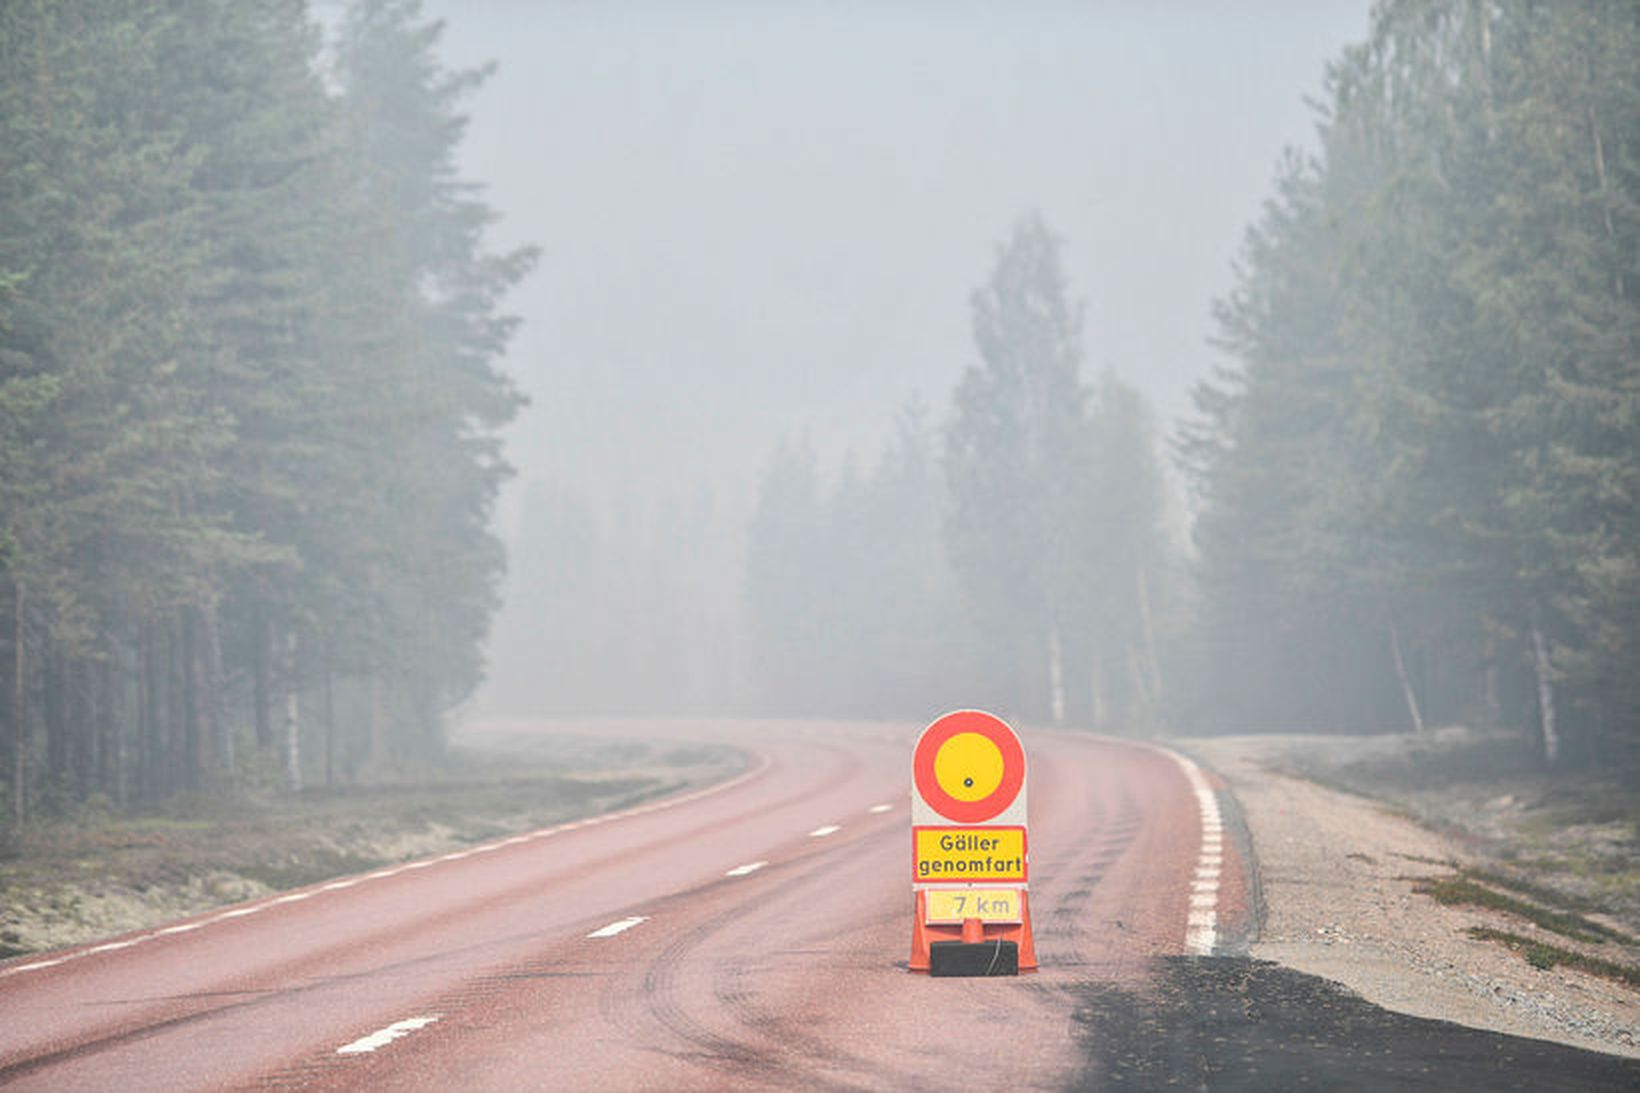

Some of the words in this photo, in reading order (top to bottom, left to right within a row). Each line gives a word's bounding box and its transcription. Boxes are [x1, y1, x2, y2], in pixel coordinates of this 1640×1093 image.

[940, 835, 1000, 852] Gäller
[919, 857, 1021, 876] genomfart
[953, 896, 967, 913] 7
[977, 896, 1010, 913] km
